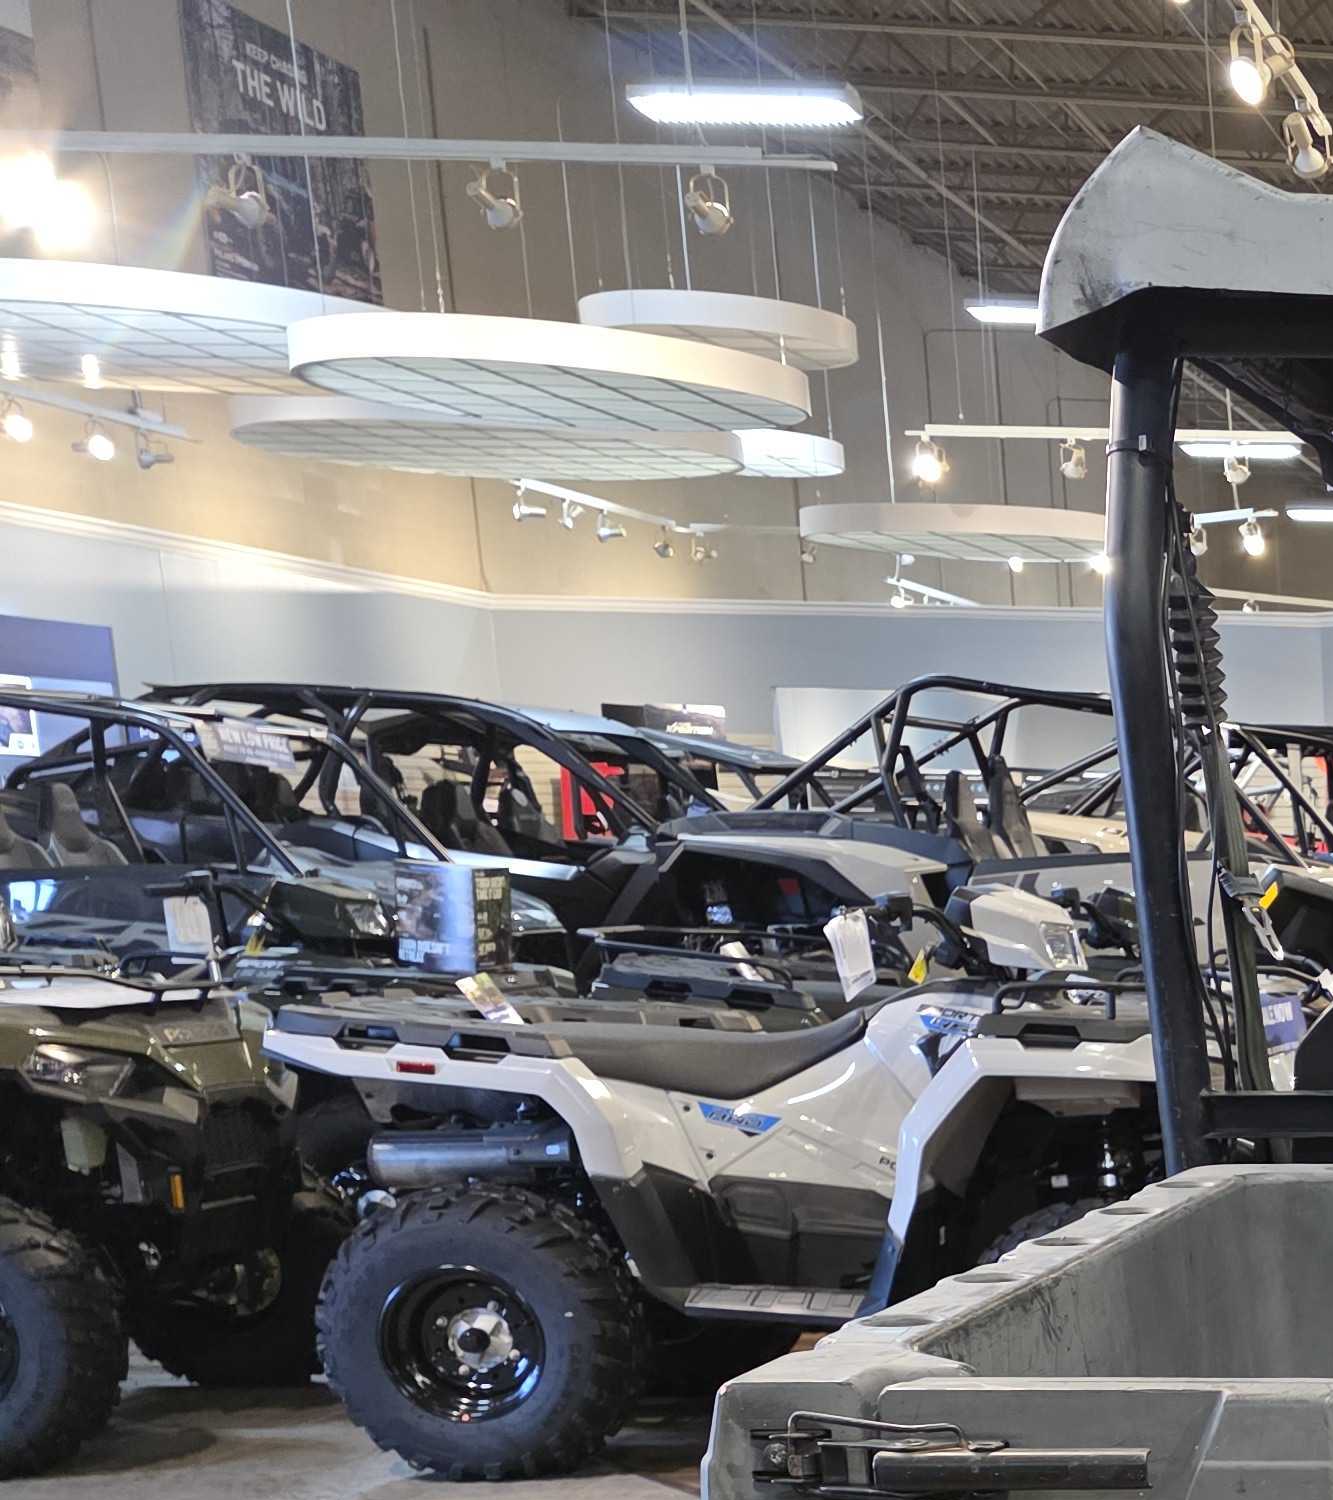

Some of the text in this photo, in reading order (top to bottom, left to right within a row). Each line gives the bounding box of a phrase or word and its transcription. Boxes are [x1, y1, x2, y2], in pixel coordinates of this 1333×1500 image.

[245, 41, 269, 63] KEEP
[232, 58, 327, 132] THE WLD
